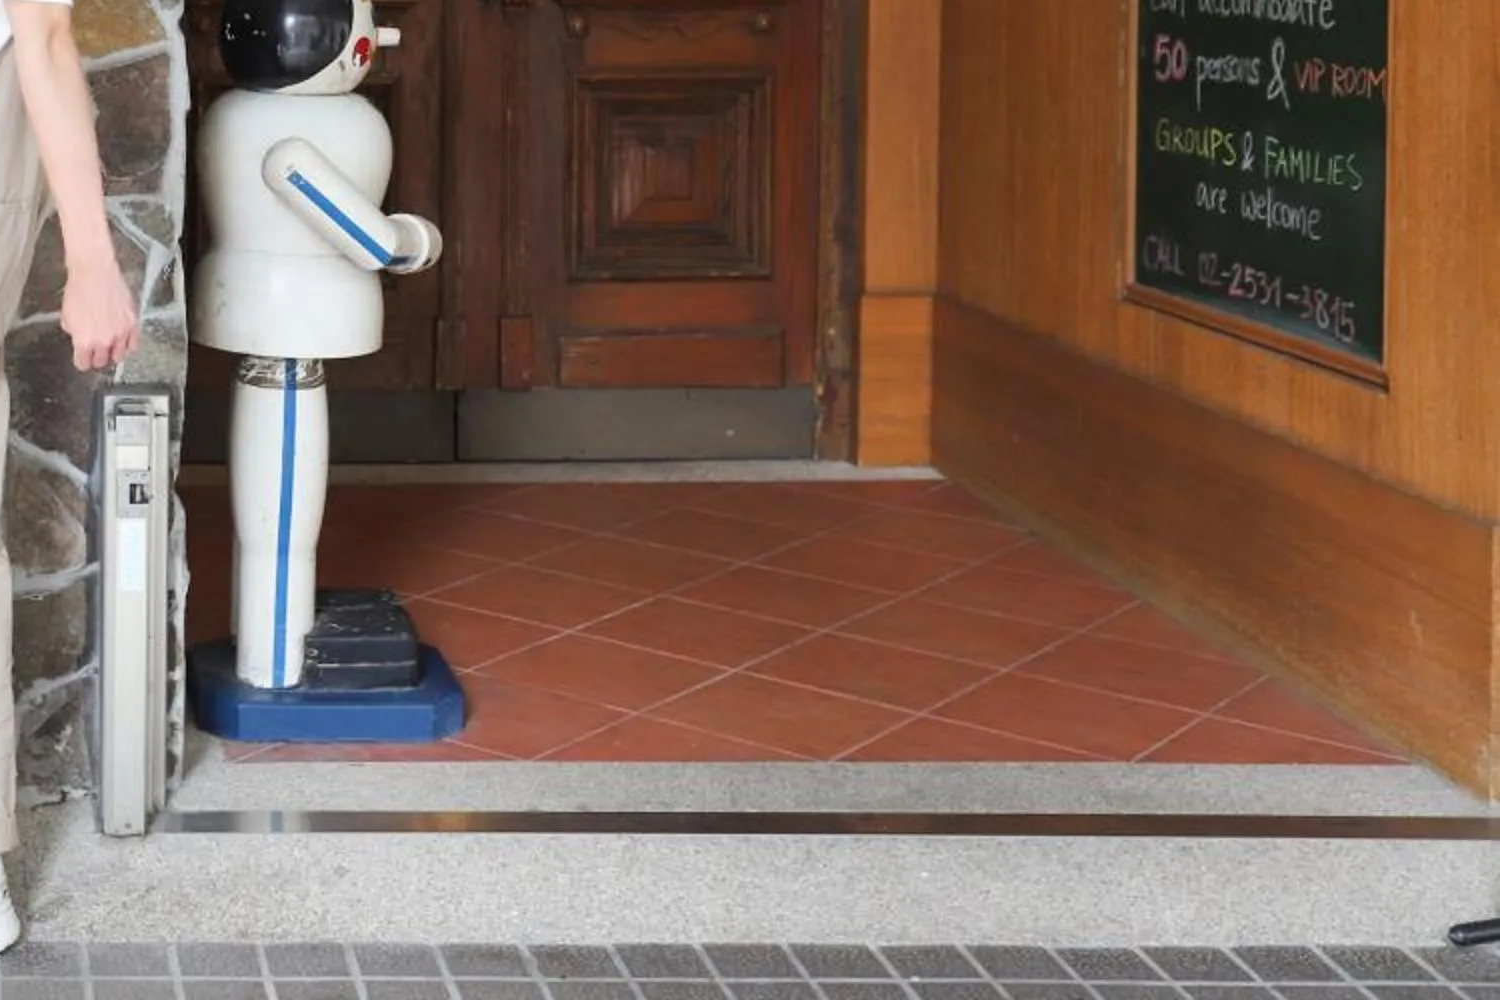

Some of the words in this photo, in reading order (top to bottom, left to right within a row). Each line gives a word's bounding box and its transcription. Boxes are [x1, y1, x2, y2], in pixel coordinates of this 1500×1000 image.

[1154, 33, 1188, 83] 50
[1196, 54, 1262, 113] persons
[1267, 36, 1290, 112] &
[1295, 56, 1326, 93] VIP
[1332, 63, 1388, 100] ROOM
[1155, 118, 1236, 167] GROUPS
[1241, 130, 1255, 172] &
[1264, 135, 1363, 191] FAMILIES
[1197, 182, 1228, 214] are
[1241, 187, 1323, 240] welcome
[1143, 235, 1185, 276] CALL
